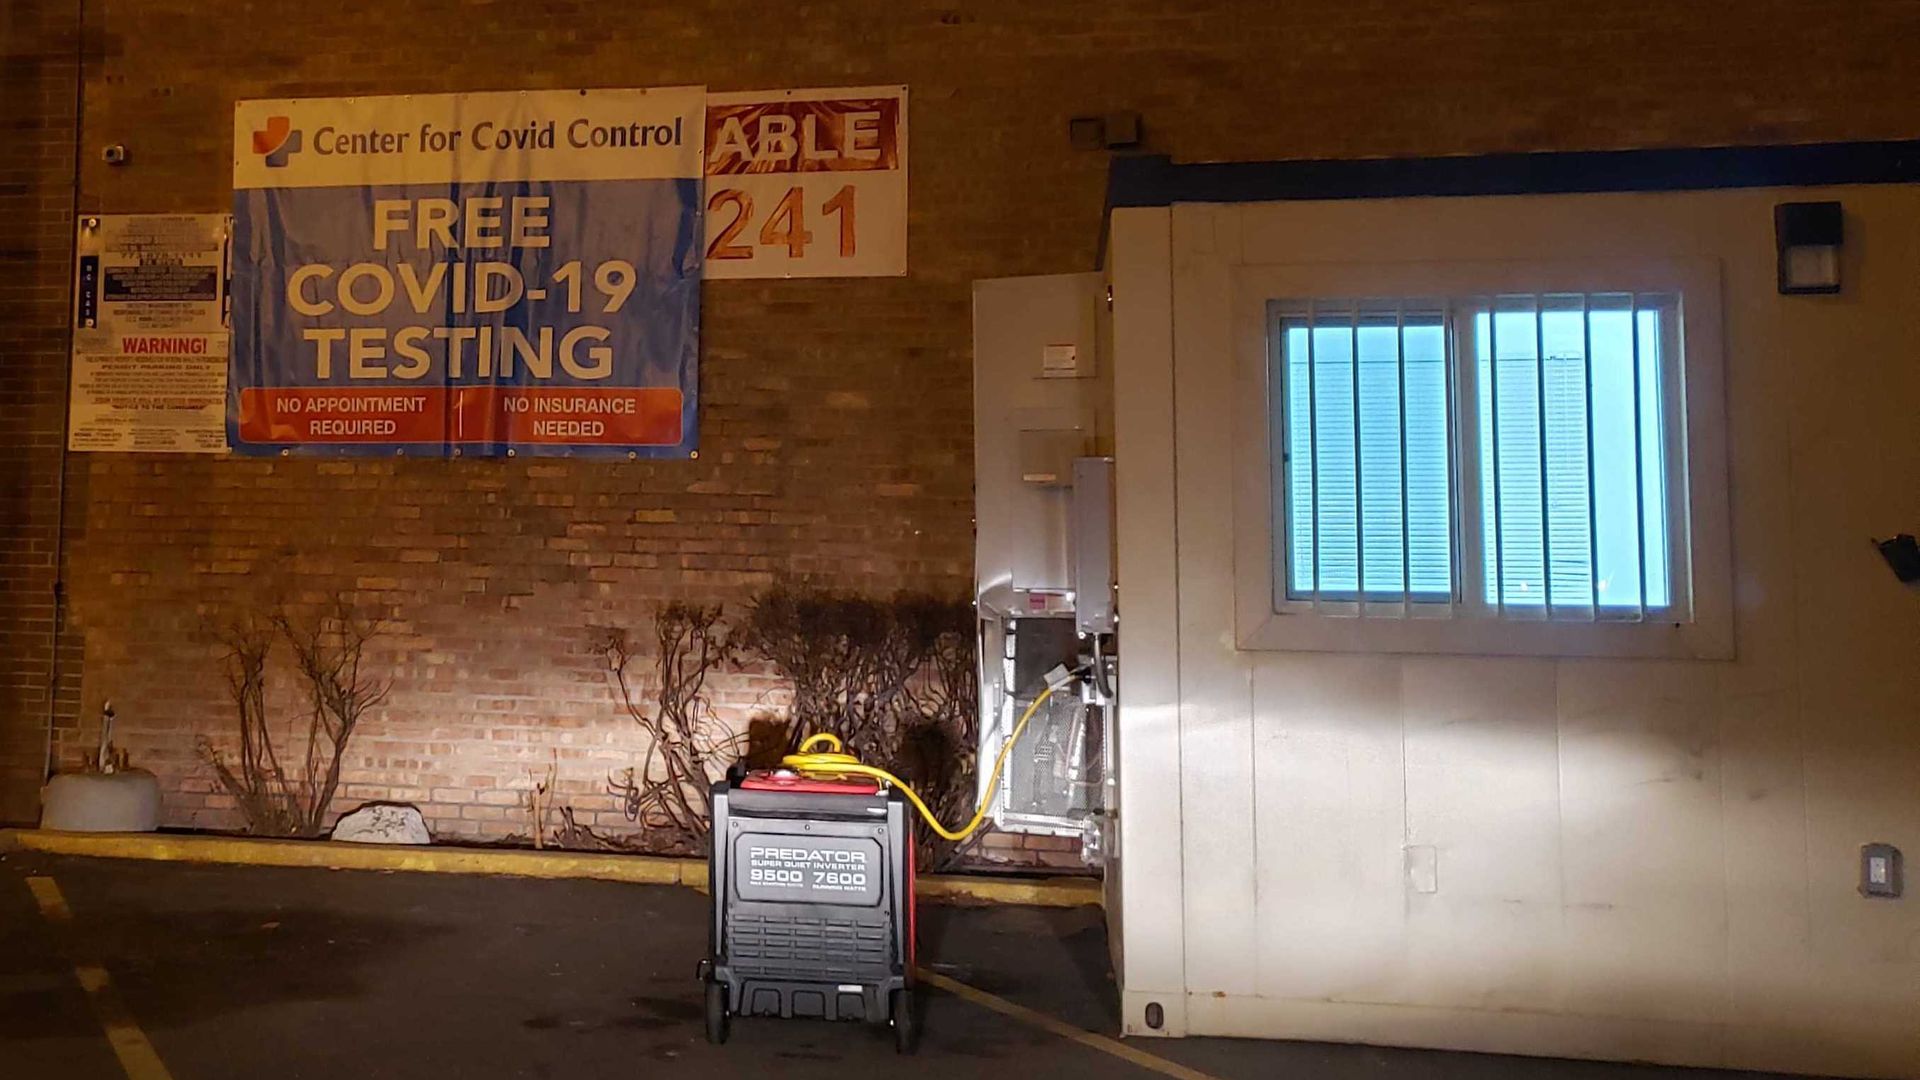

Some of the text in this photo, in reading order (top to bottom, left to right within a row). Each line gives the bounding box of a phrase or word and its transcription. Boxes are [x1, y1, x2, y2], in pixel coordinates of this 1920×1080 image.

[313, 117, 683, 154] Center for Covid Control
[710, 111, 881, 163] ABLE
[374, 196, 551, 250] FREE
[705, 185, 855, 260] 241
[288, 260, 637, 316] COVID-19
[122, 337, 207, 355] WARNING!
[303, 326, 613, 379] TESTING
[276, 397, 426, 413] NO APPOINTMENT
[503, 397, 636, 414] NO INSURANCE
[310, 419, 396, 435] REQUIRED
[533, 420, 605, 436] NEEDED
[750, 847, 866, 863] PREDATOR
[814, 862, 865, 871] INVERTER
[750, 869, 866, 885] 9500 7600
